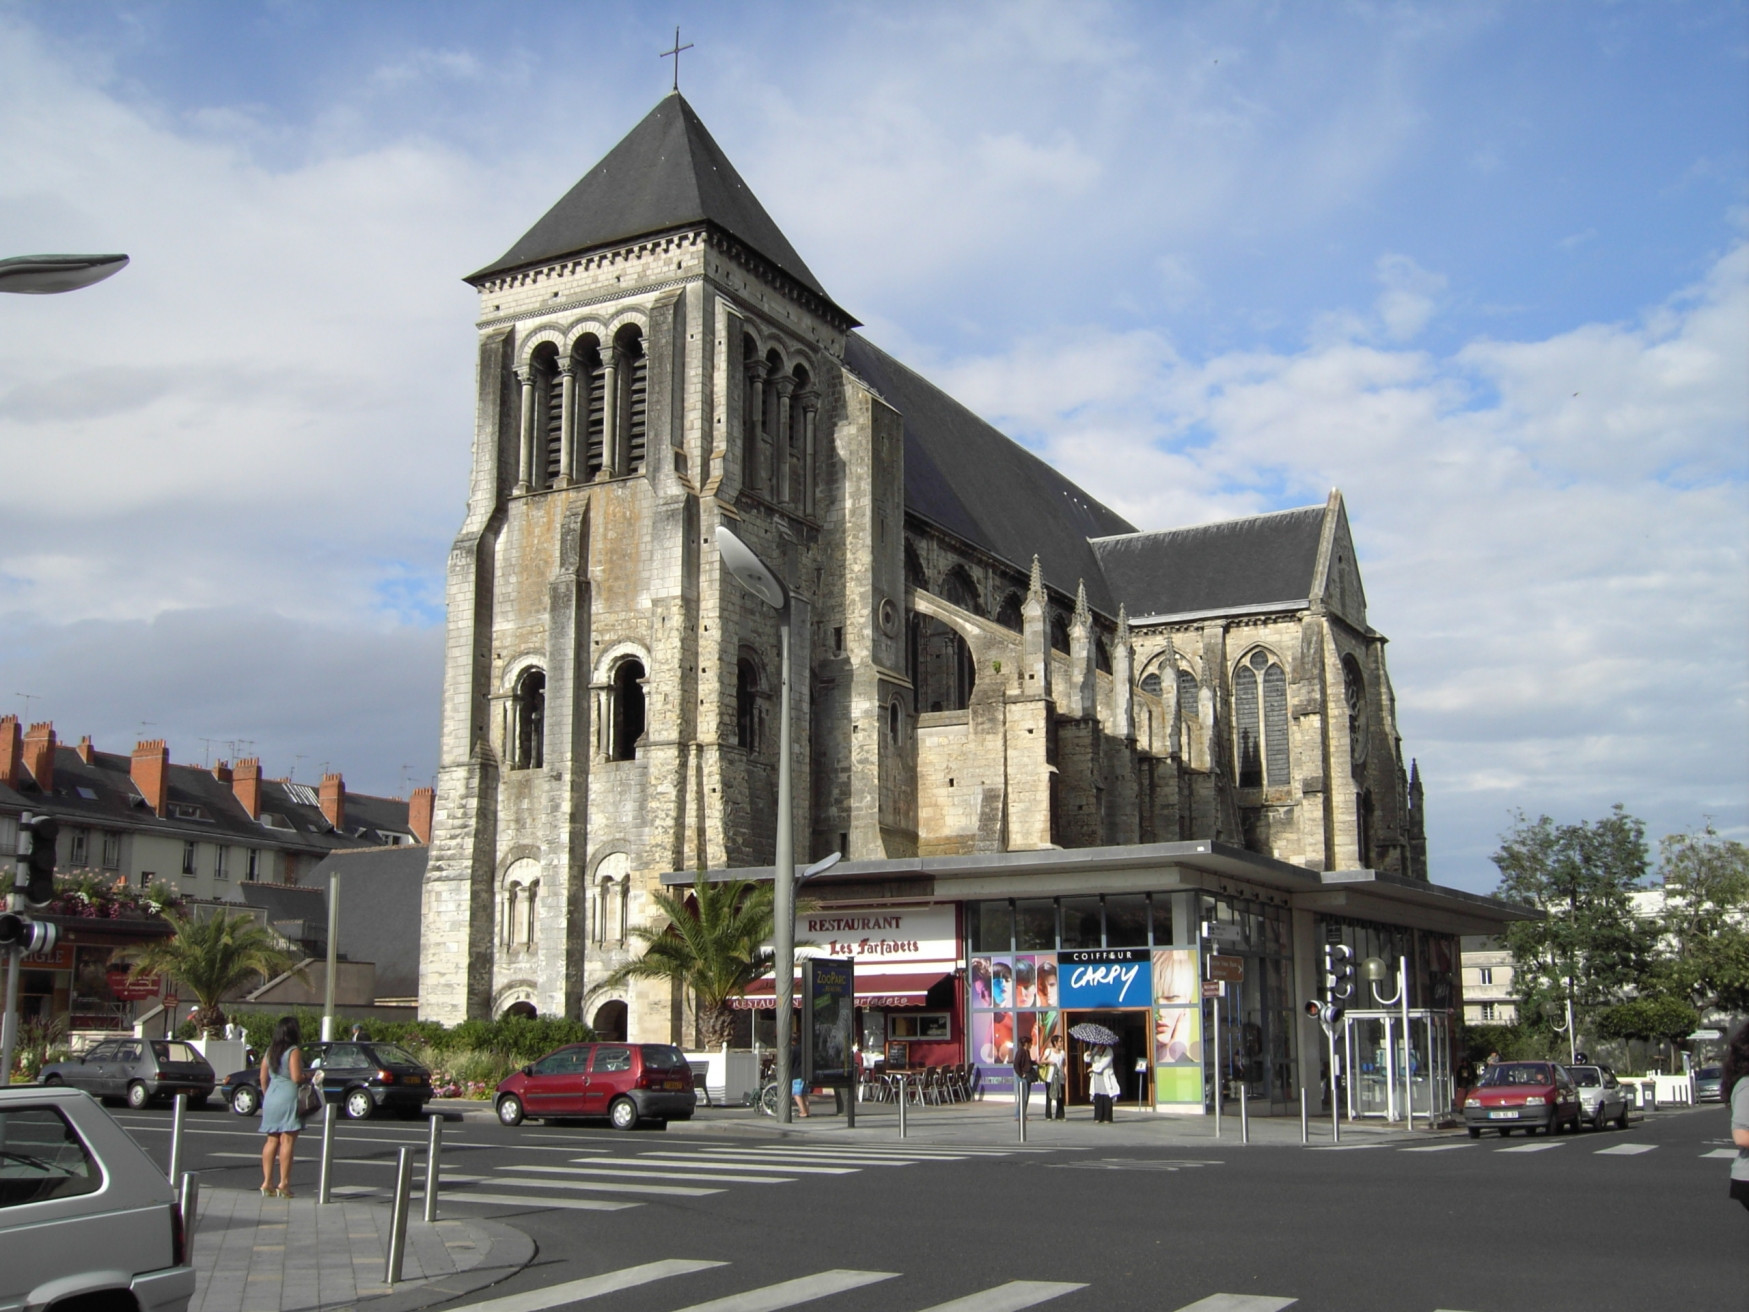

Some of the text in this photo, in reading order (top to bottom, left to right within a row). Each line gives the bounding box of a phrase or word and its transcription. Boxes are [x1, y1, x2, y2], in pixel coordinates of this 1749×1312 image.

[808, 917, 902, 932] RESTAURANT
[829, 938, 919, 956] Les Farfadets
[1073, 951, 1132, 961] COIFFEUR
[1070, 964, 1139, 1002] CARPY
